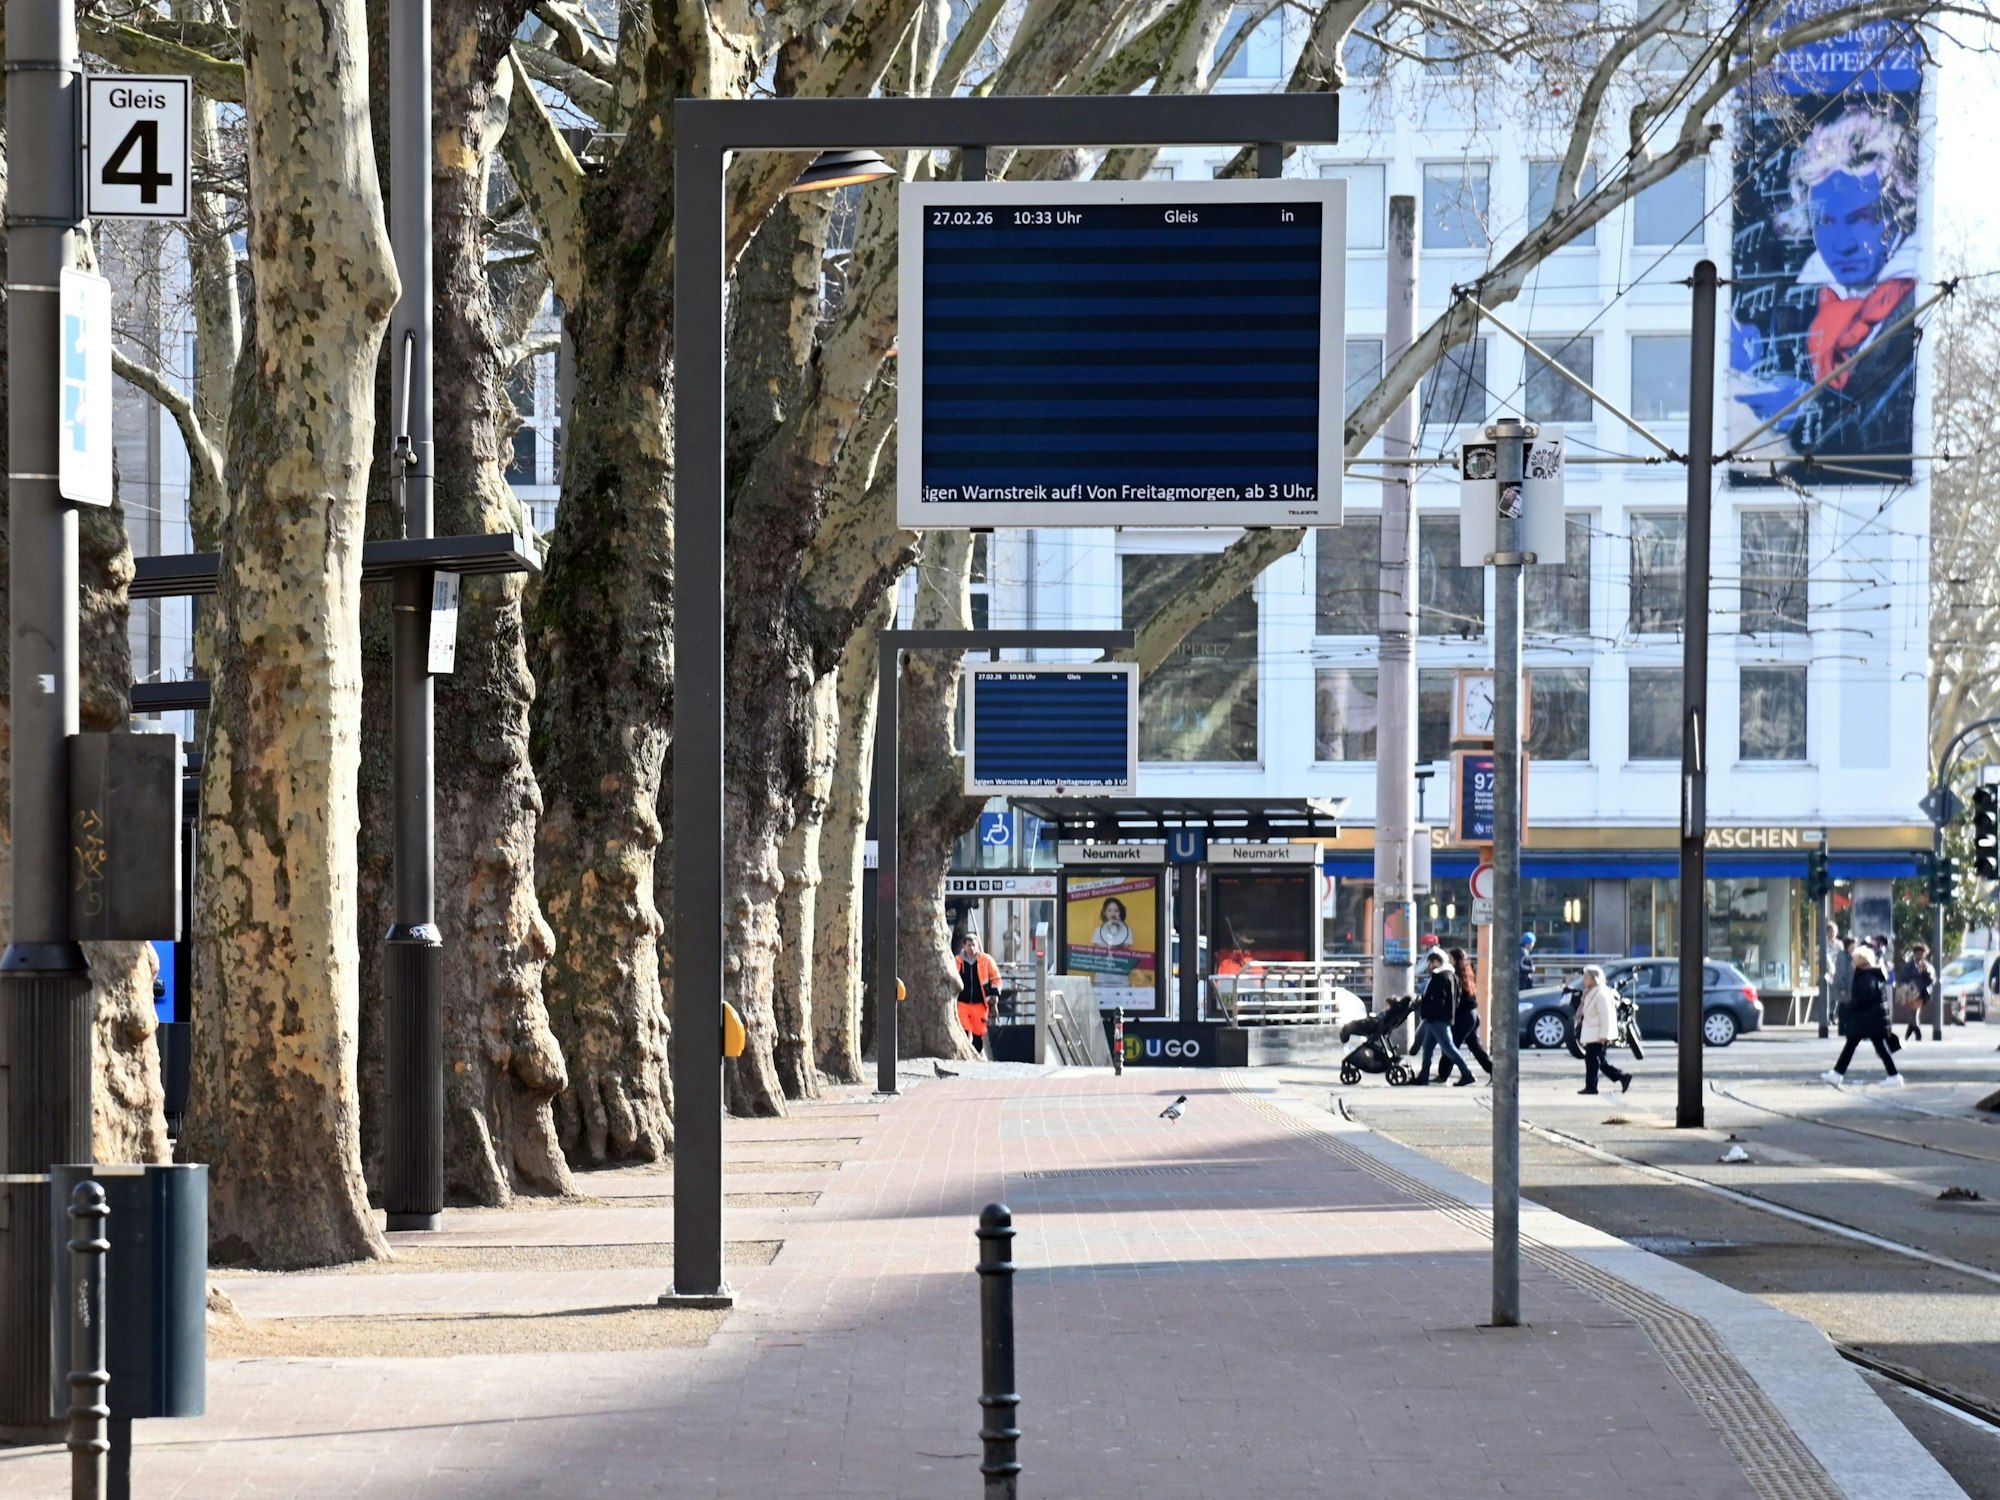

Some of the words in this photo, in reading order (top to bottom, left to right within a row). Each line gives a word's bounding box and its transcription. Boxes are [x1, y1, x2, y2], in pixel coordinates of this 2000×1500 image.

[109, 88, 166, 109] Gleis
[102, 120, 173, 204] 4
[933, 212, 994, 225] 27.02.26
[1014, 211, 1051, 225] 10:33
[1056, 210, 1082, 224] Uhr
[1164, 209, 1199, 223] Gleis
[1281, 209, 1295, 222] in
[923, 485, 958, 502] igen
[962, 485, 1047, 499] Warnstreik
[1051, 484, 1082, 499] auf!
[1087, 485, 1117, 499] Von
[1121, 484, 1240, 501] Freitagmorgen,
[1245, 483, 1265, 498] ab
[1269, 484, 1279, 498] 3
[1283, 483, 1316, 500] Uhr,
[1043, 778, 1057, 786] Von
[1175, 833, 1195, 857] U
[1703, 828, 1798, 849] ASCHEN
[1082, 848, 1141, 859] Neumarkt
[1232, 847, 1290, 859] Neumarkt
